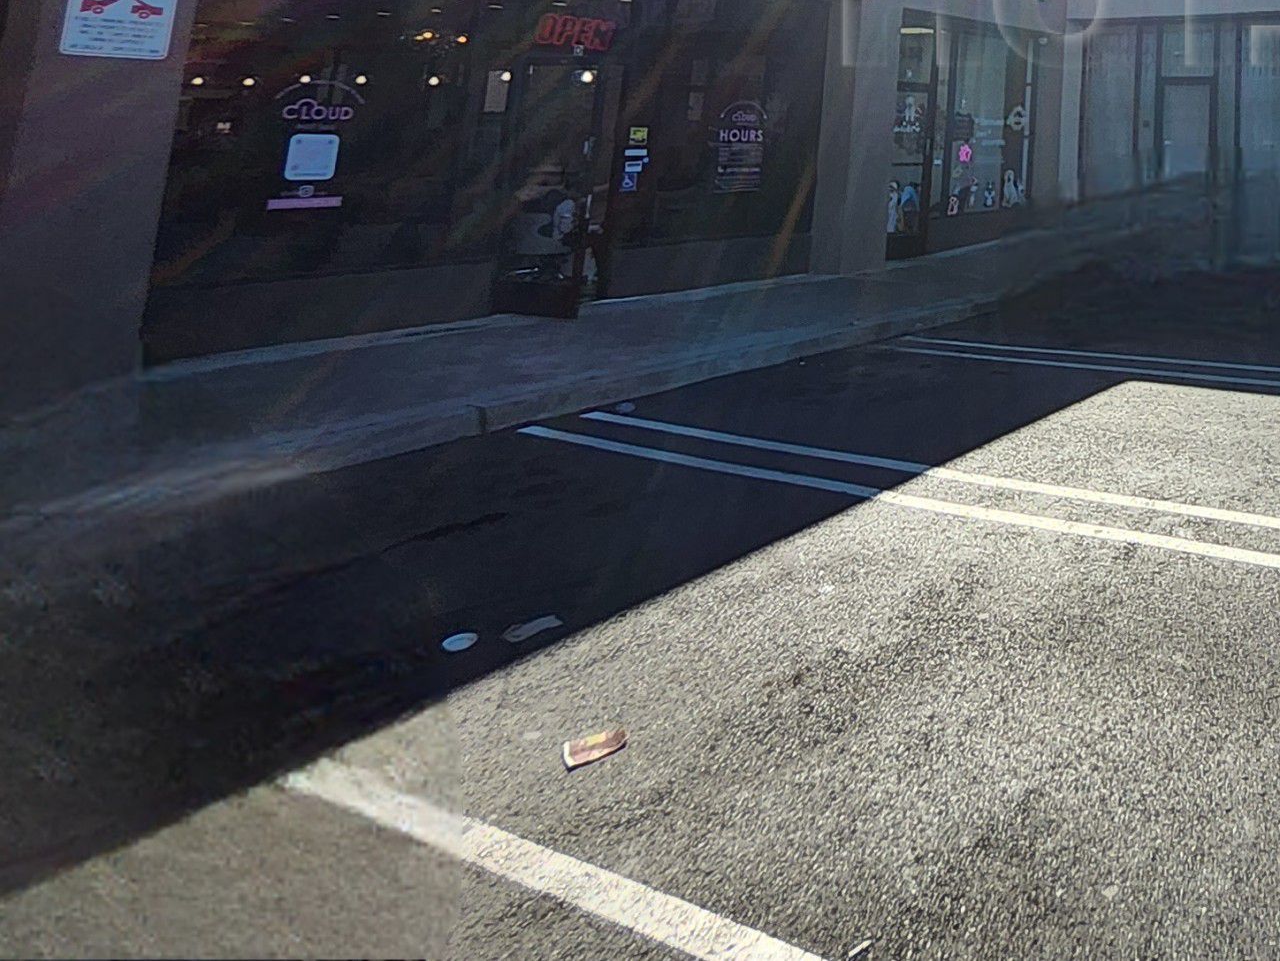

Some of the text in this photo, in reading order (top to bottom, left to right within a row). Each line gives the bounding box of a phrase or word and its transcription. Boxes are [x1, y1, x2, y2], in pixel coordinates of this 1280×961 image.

[533, 12, 618, 52] OPEN
[282, 98, 354, 120] CLOUD
[719, 128, 764, 142] HOURS
